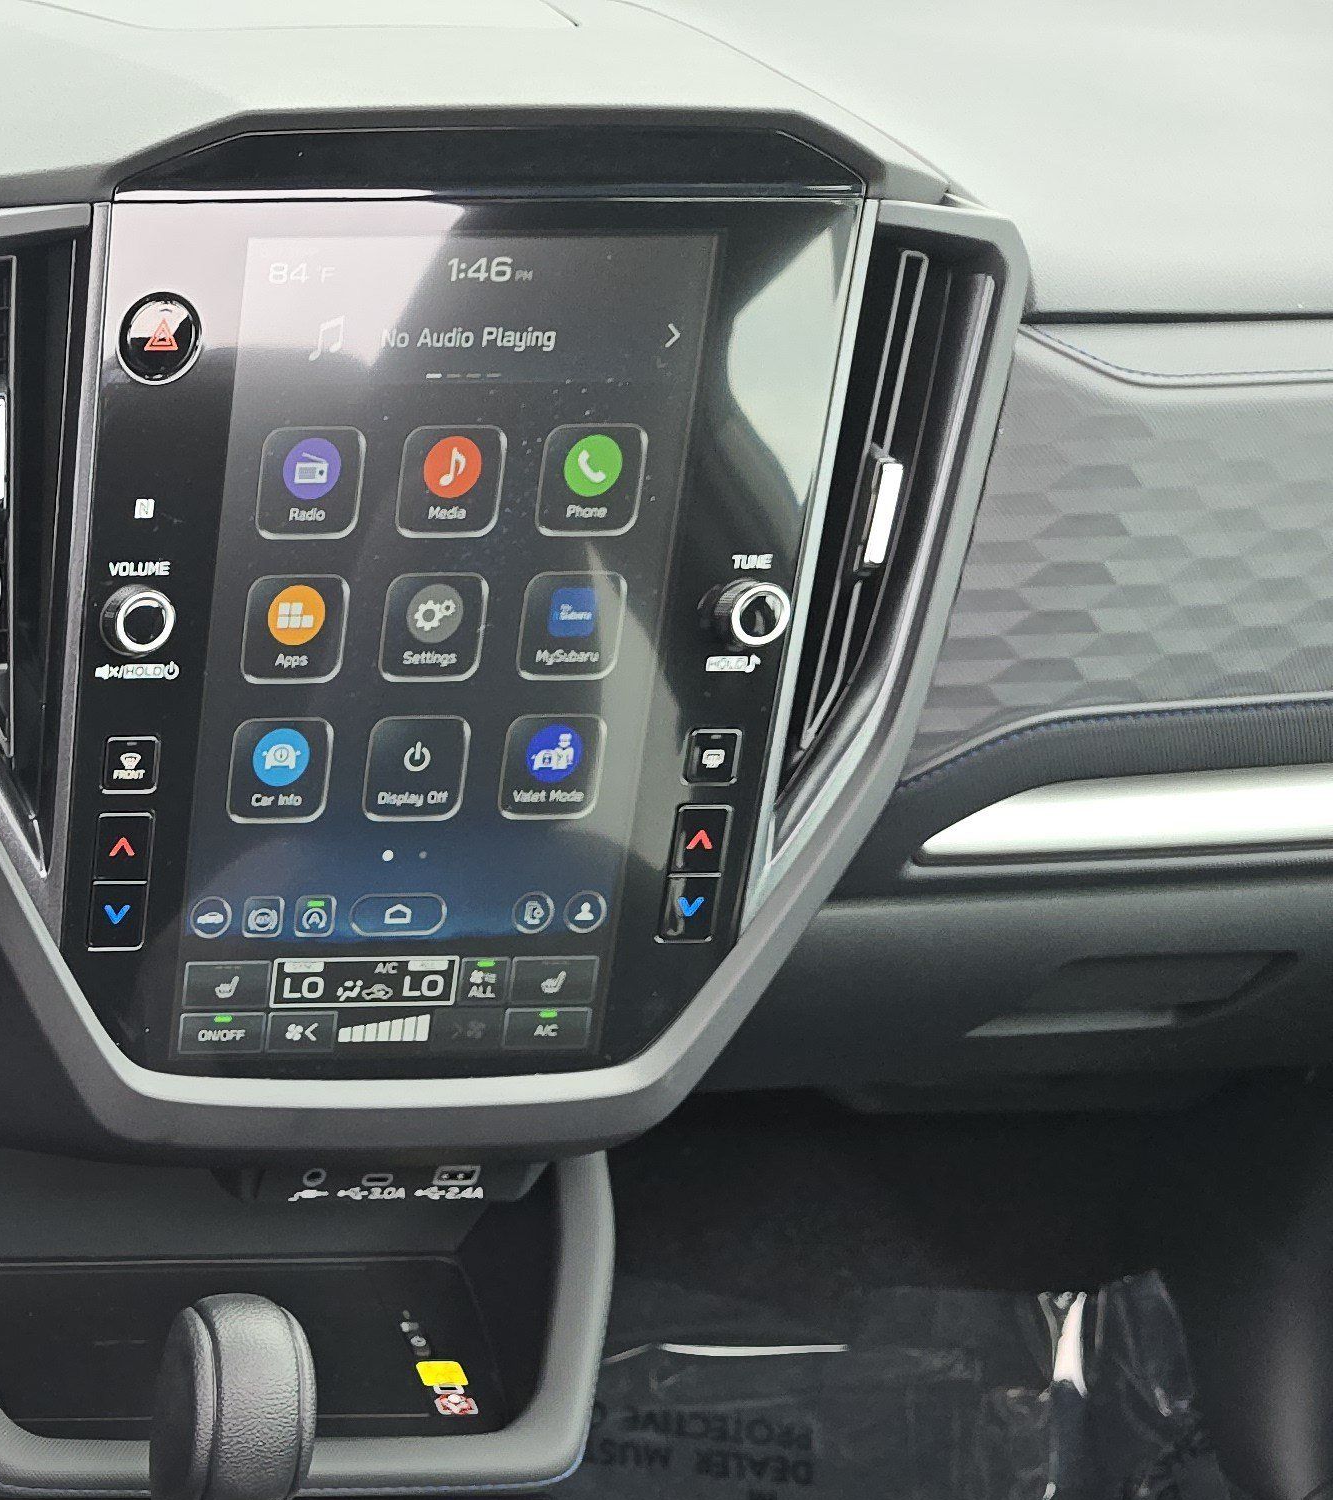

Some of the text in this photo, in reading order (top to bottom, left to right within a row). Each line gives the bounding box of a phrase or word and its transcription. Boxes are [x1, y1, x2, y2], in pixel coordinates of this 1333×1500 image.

[269, 262, 309, 283] 84
[448, 256, 513, 282] 1:46
[383, 326, 557, 352] No Audio Playing
[288, 507, 326, 522] Radio
[428, 505, 467, 520] Media
[566, 504, 607, 519] Phone
[732, 553, 773, 569] TUNE
[109, 561, 171, 577] VOLUME
[275, 653, 309, 668] Apps
[403, 650, 458, 667] Settings
[535, 649, 600, 665] MySubaru
[123, 664, 164, 679] HOLD
[112, 769, 145, 780] FRONT
[251, 793, 303, 807] Car Info
[377, 790, 448, 807] Display Off
[513, 789, 584, 803] Valet Mode
[374, 962, 399, 974] A/C
[283, 976, 325, 999] LO
[402, 974, 444, 997] LO
[468, 986, 496, 998] ALL
[197, 1029, 246, 1042] ON/OFF
[533, 1024, 559, 1037] A/C
